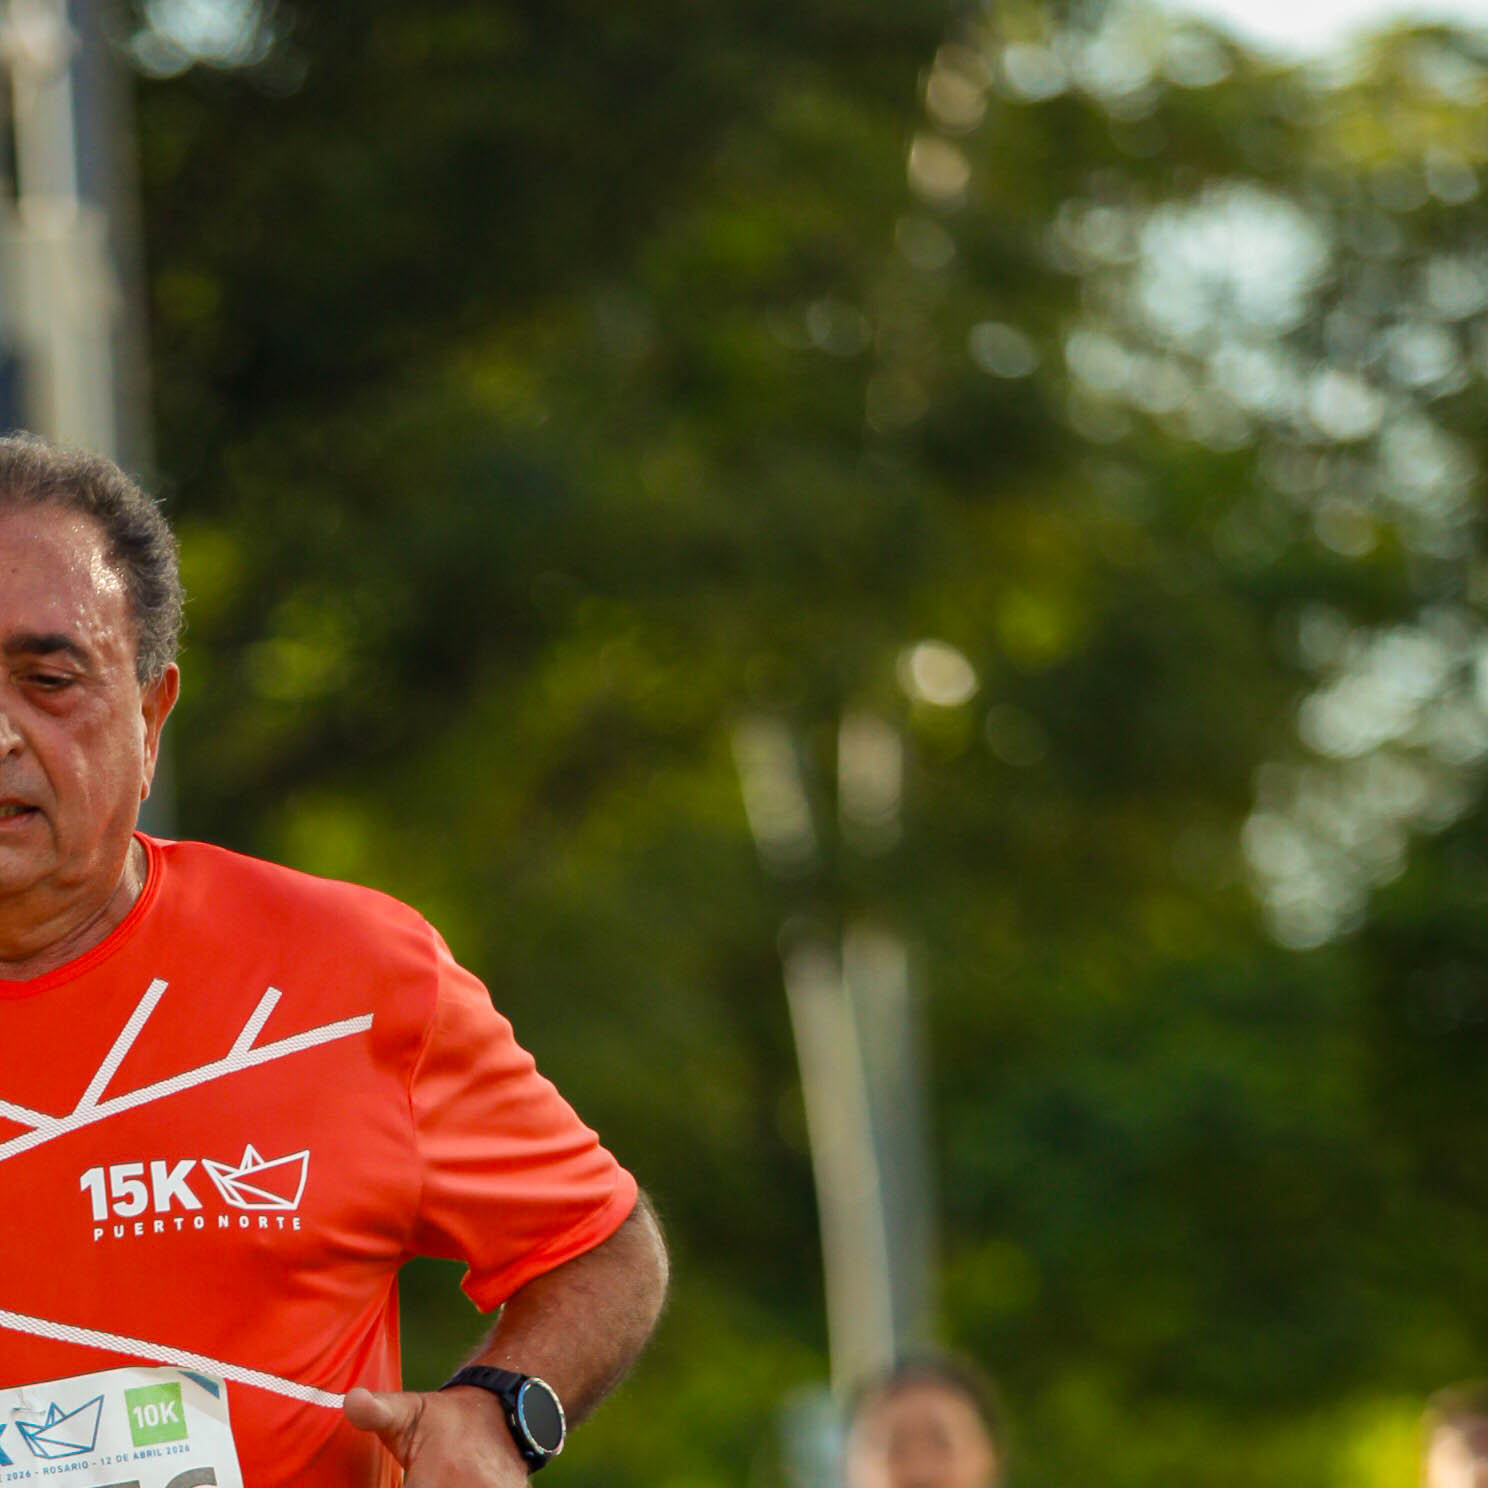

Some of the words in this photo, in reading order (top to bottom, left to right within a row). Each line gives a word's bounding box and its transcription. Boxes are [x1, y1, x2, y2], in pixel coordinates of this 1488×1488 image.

[80, 1160, 203, 1222] 15K
[93, 1216, 205, 1242] PUERTO
[218, 1215, 302, 1231] NORTE
[132, 1401, 179, 1429] 10K
[7, 1470, 32, 1481] 2026
[42, 1460, 89, 1475] ROSARIO
[100, 1456, 112, 1466] 12
[115, 1453, 129, 1463] DE
[133, 1448, 163, 1460] ABRIL
